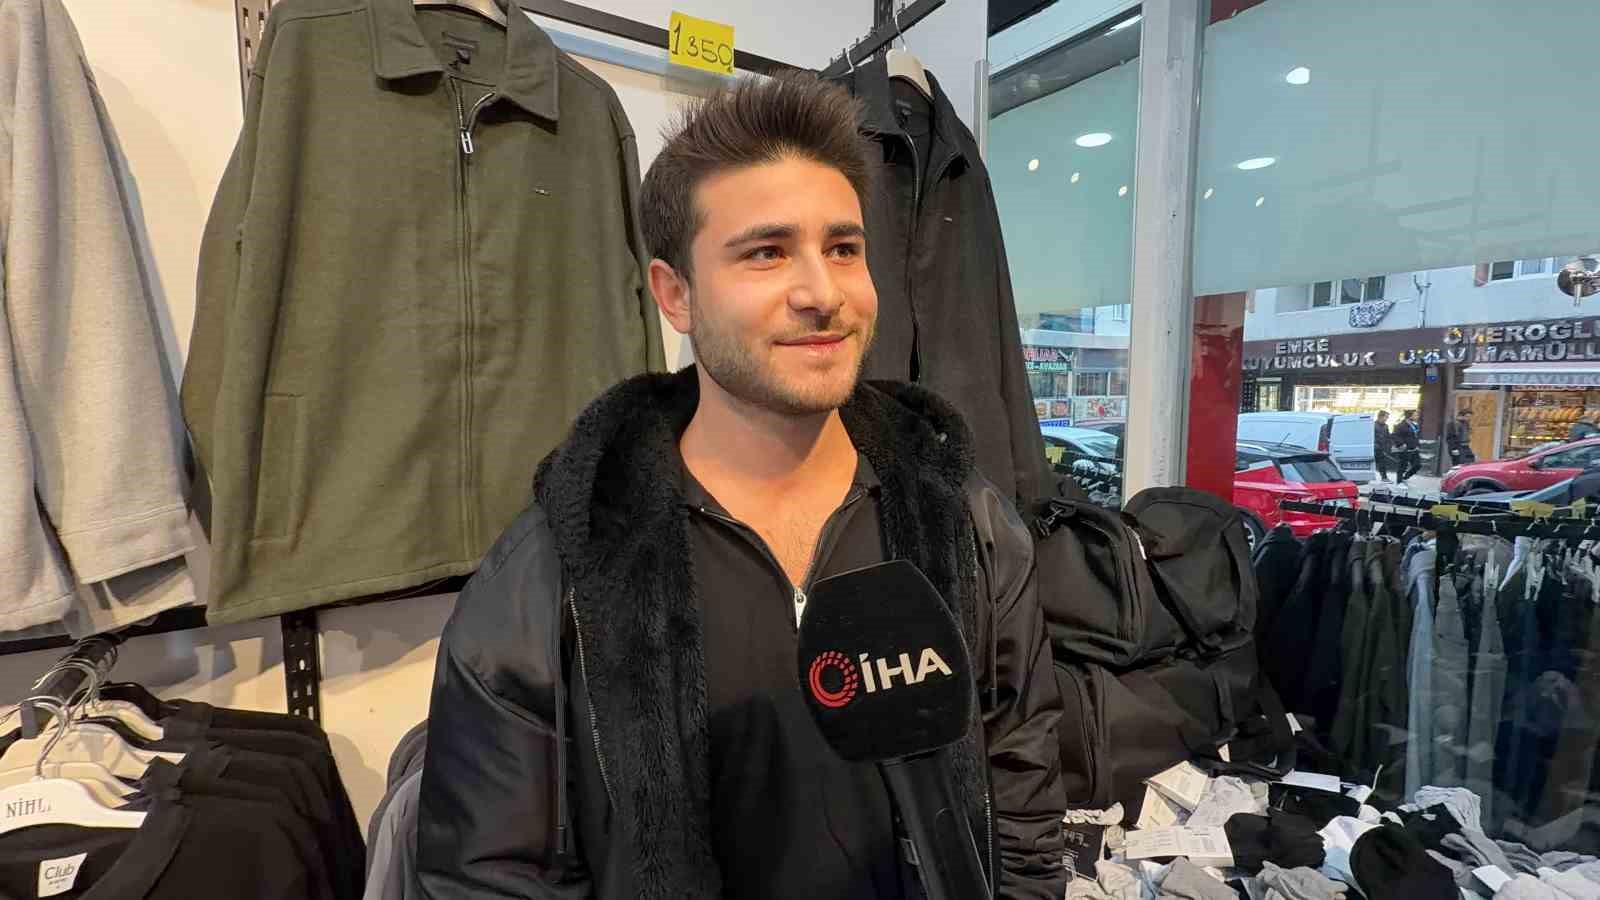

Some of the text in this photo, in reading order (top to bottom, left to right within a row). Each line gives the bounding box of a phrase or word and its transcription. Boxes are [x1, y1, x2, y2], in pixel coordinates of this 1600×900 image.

[1275, 338, 1329, 354] EMRE
[858, 647, 953, 693] İHA
[44, 863, 75, 880] Club
